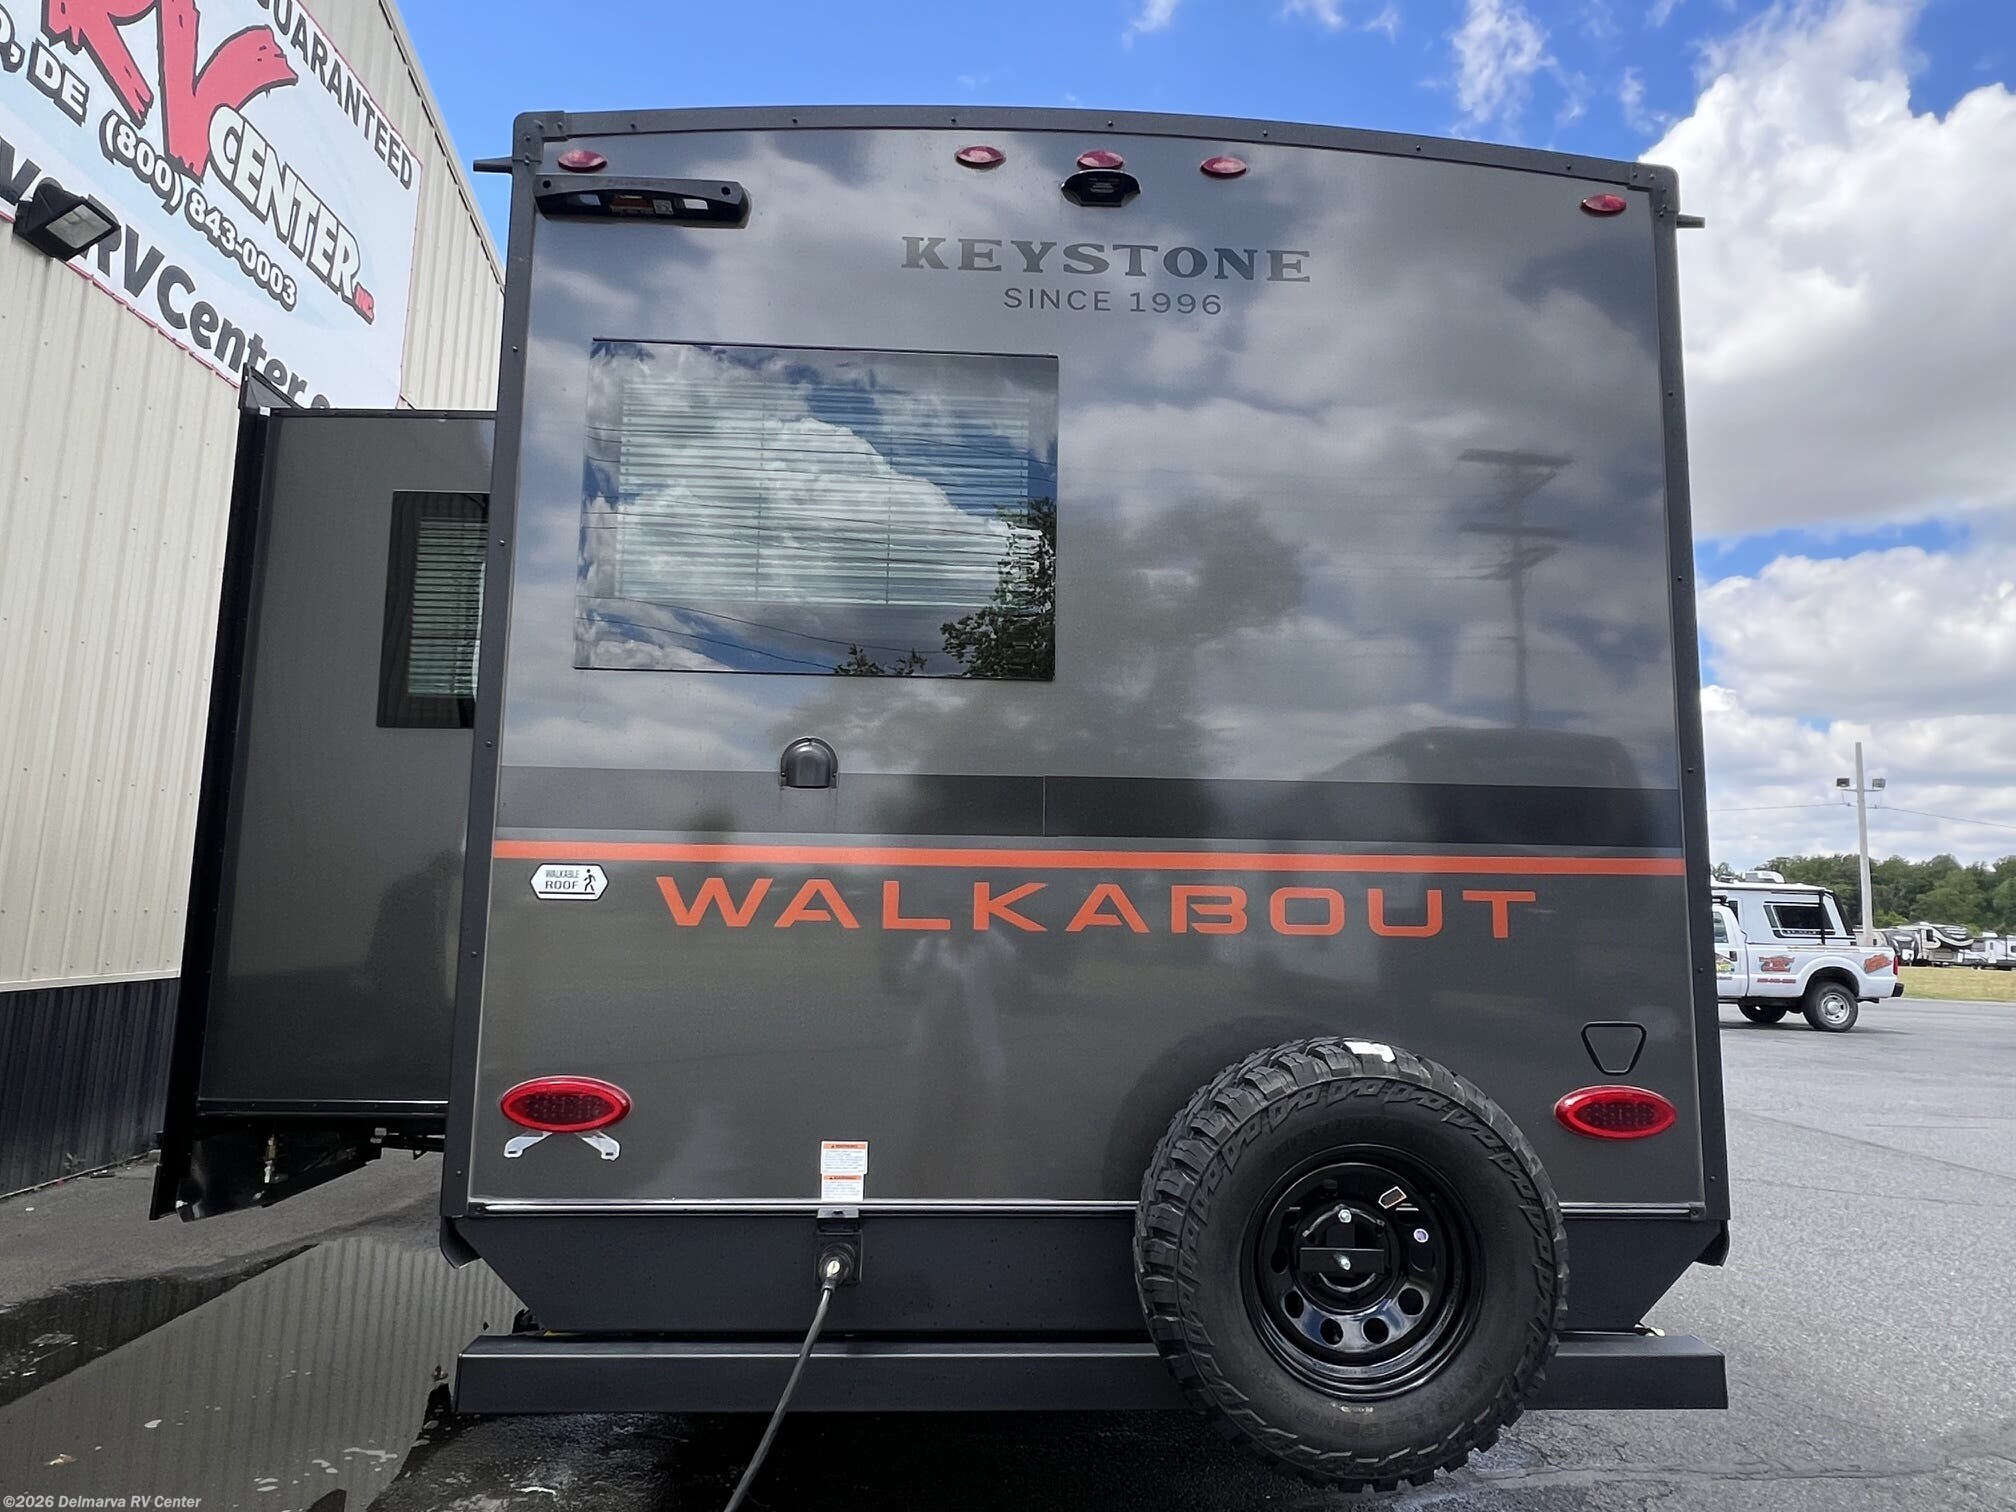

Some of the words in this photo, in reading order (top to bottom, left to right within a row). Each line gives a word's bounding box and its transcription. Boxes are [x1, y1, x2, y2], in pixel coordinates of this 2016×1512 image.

[257, 0, 413, 191] UARANTEED
[28, 39, 89, 126] DE
[101, 110, 183, 214] (800)
[185, 188, 298, 311] 843-0003
[208, 103, 361, 304] CENTER
[901, 236, 1310, 282] KEYSTONE
[1003, 288, 1111, 313] SINCE
[1129, 291, 1222, 315] 1996
[545, 880, 580, 889] ROOF
[656, 876, 1536, 938] WALKABOUT
